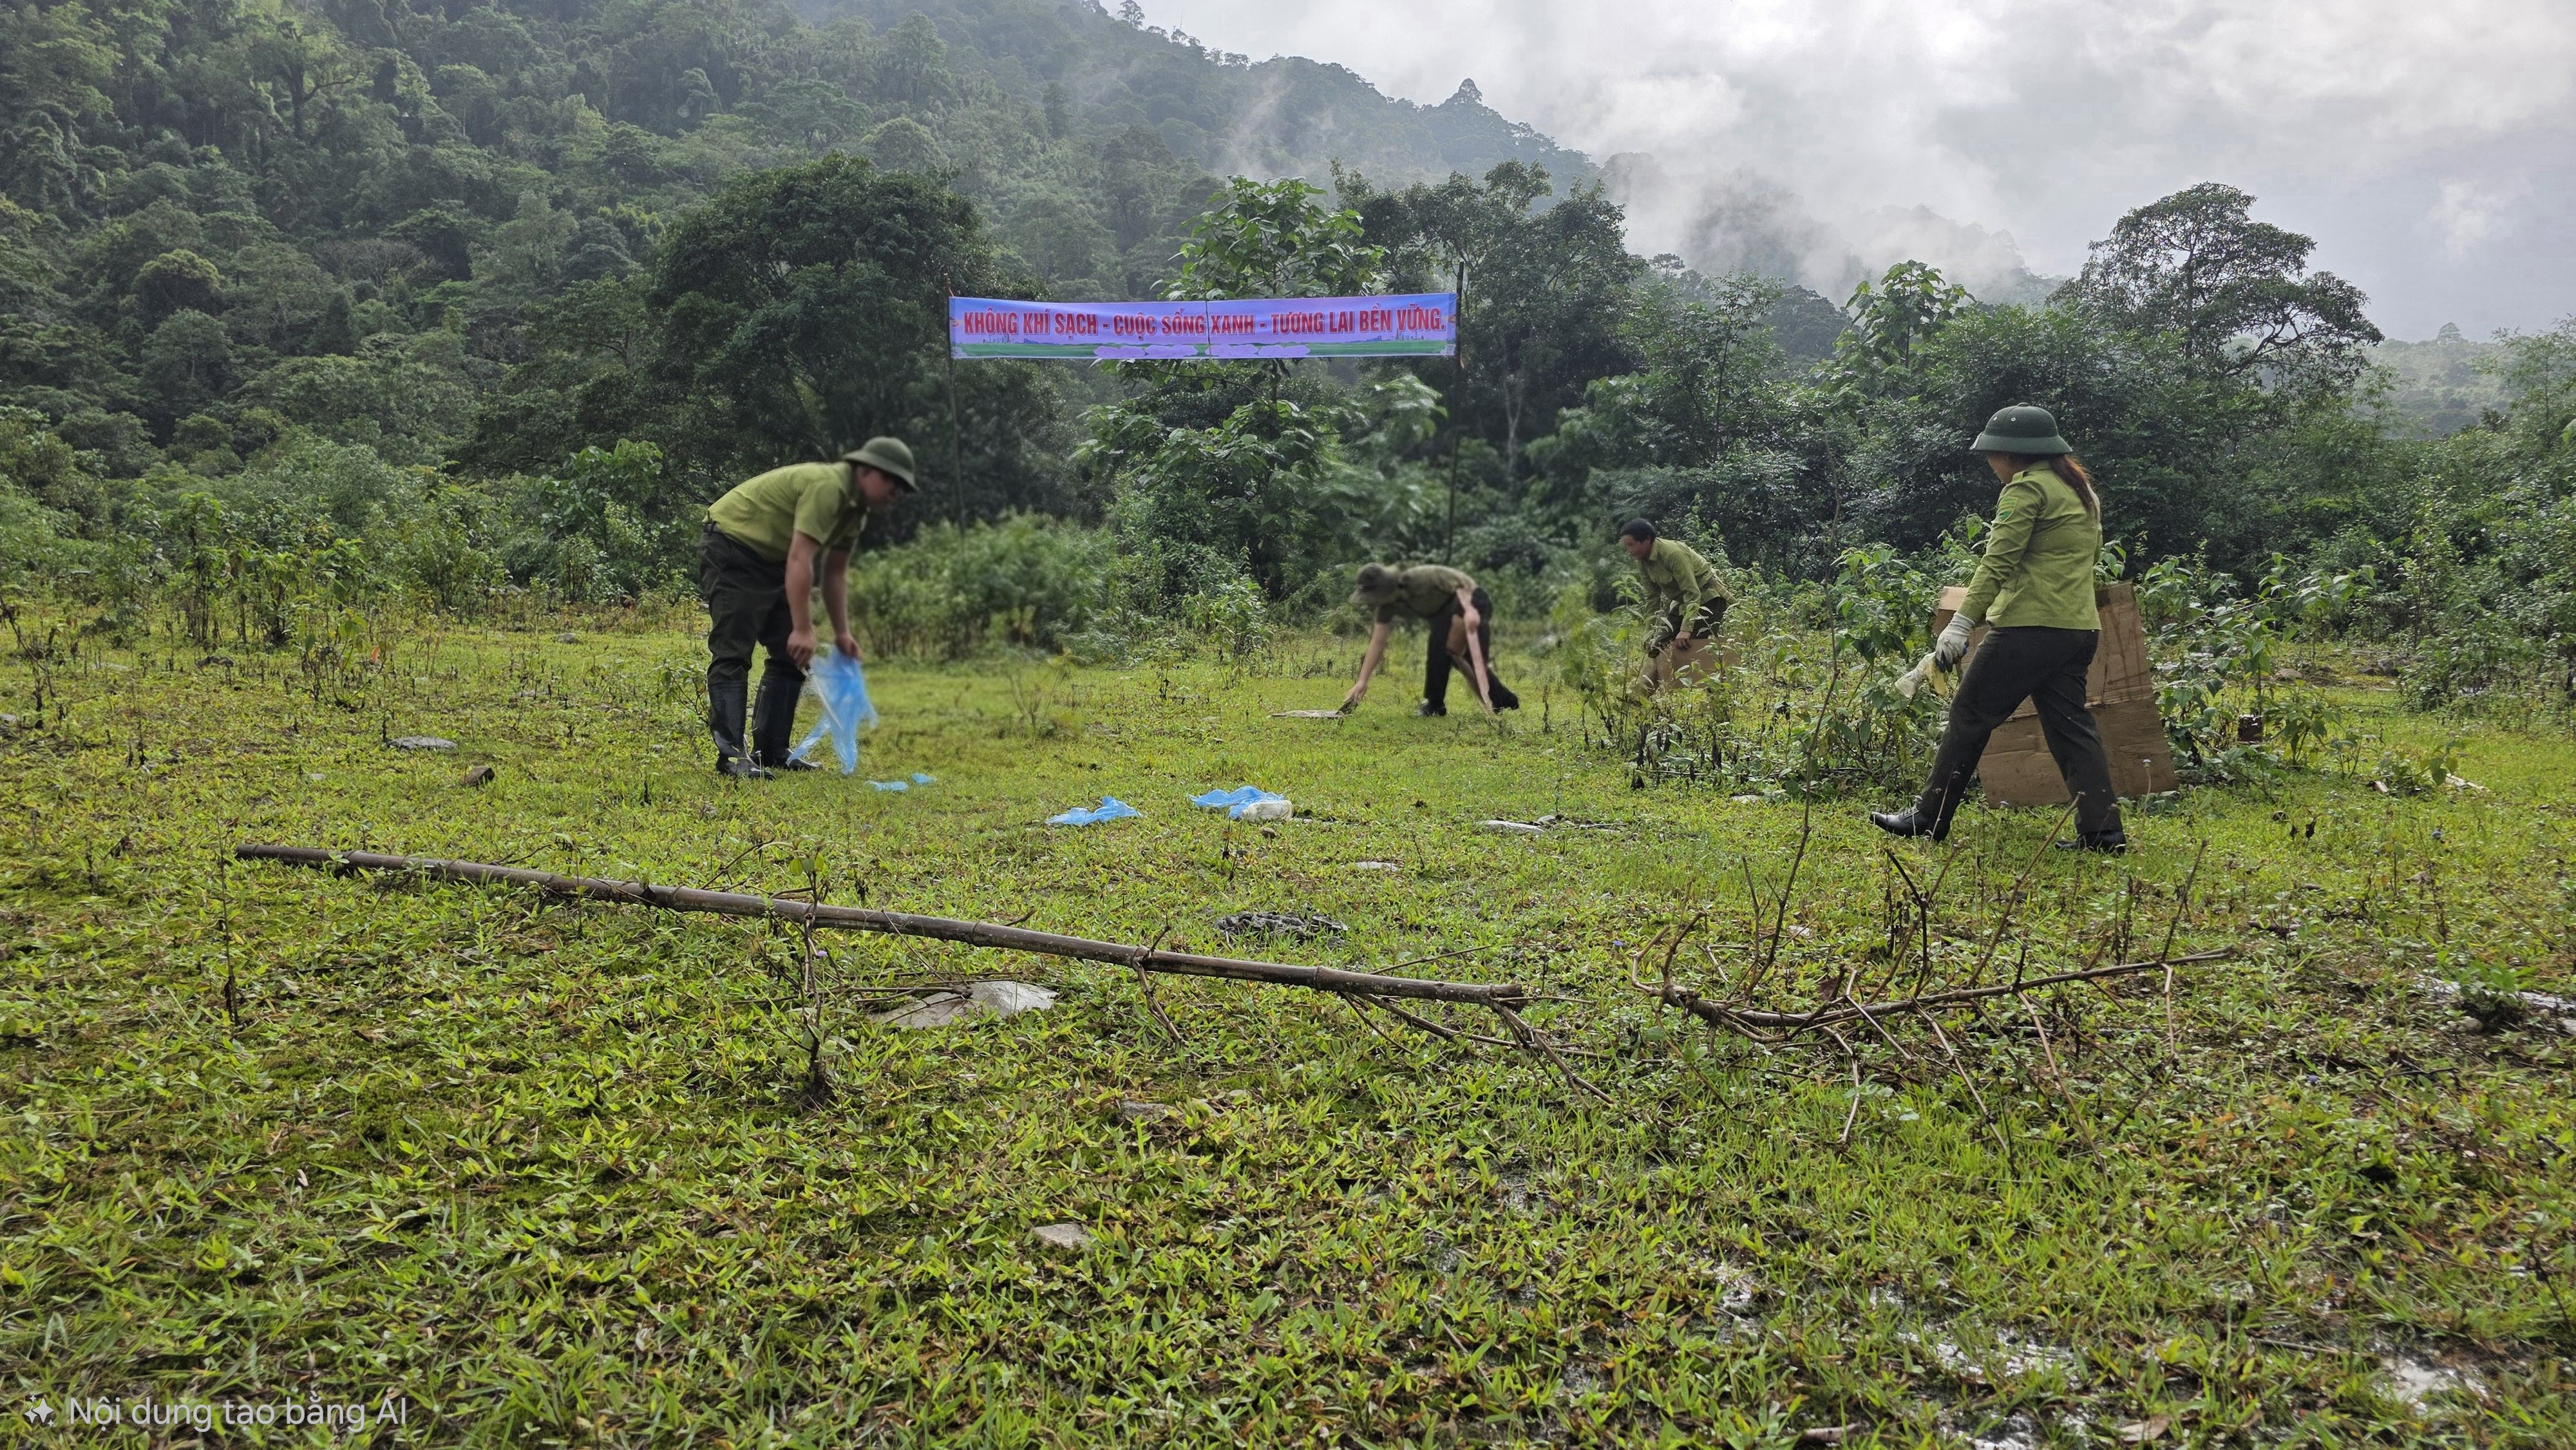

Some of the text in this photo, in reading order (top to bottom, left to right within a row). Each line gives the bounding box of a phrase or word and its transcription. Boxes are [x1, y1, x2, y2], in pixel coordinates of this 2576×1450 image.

[964, 308, 1018, 334] KHÔNG
[1023, 308, 1050, 334] KHÍ
[1055, 313, 1098, 340] SẠCH
[1113, 312, 1157, 340] CUỘC
[1161, 308, 1206, 335] SỐNG
[1211, 314, 1255, 334] XANH
[1271, 311, 1325, 334] TƯƠNG
[1329, 311, 1354, 333] LAI
[1359, 303, 1391, 332] BỀN
[1397, 303, 1445, 331] VỮNG.
